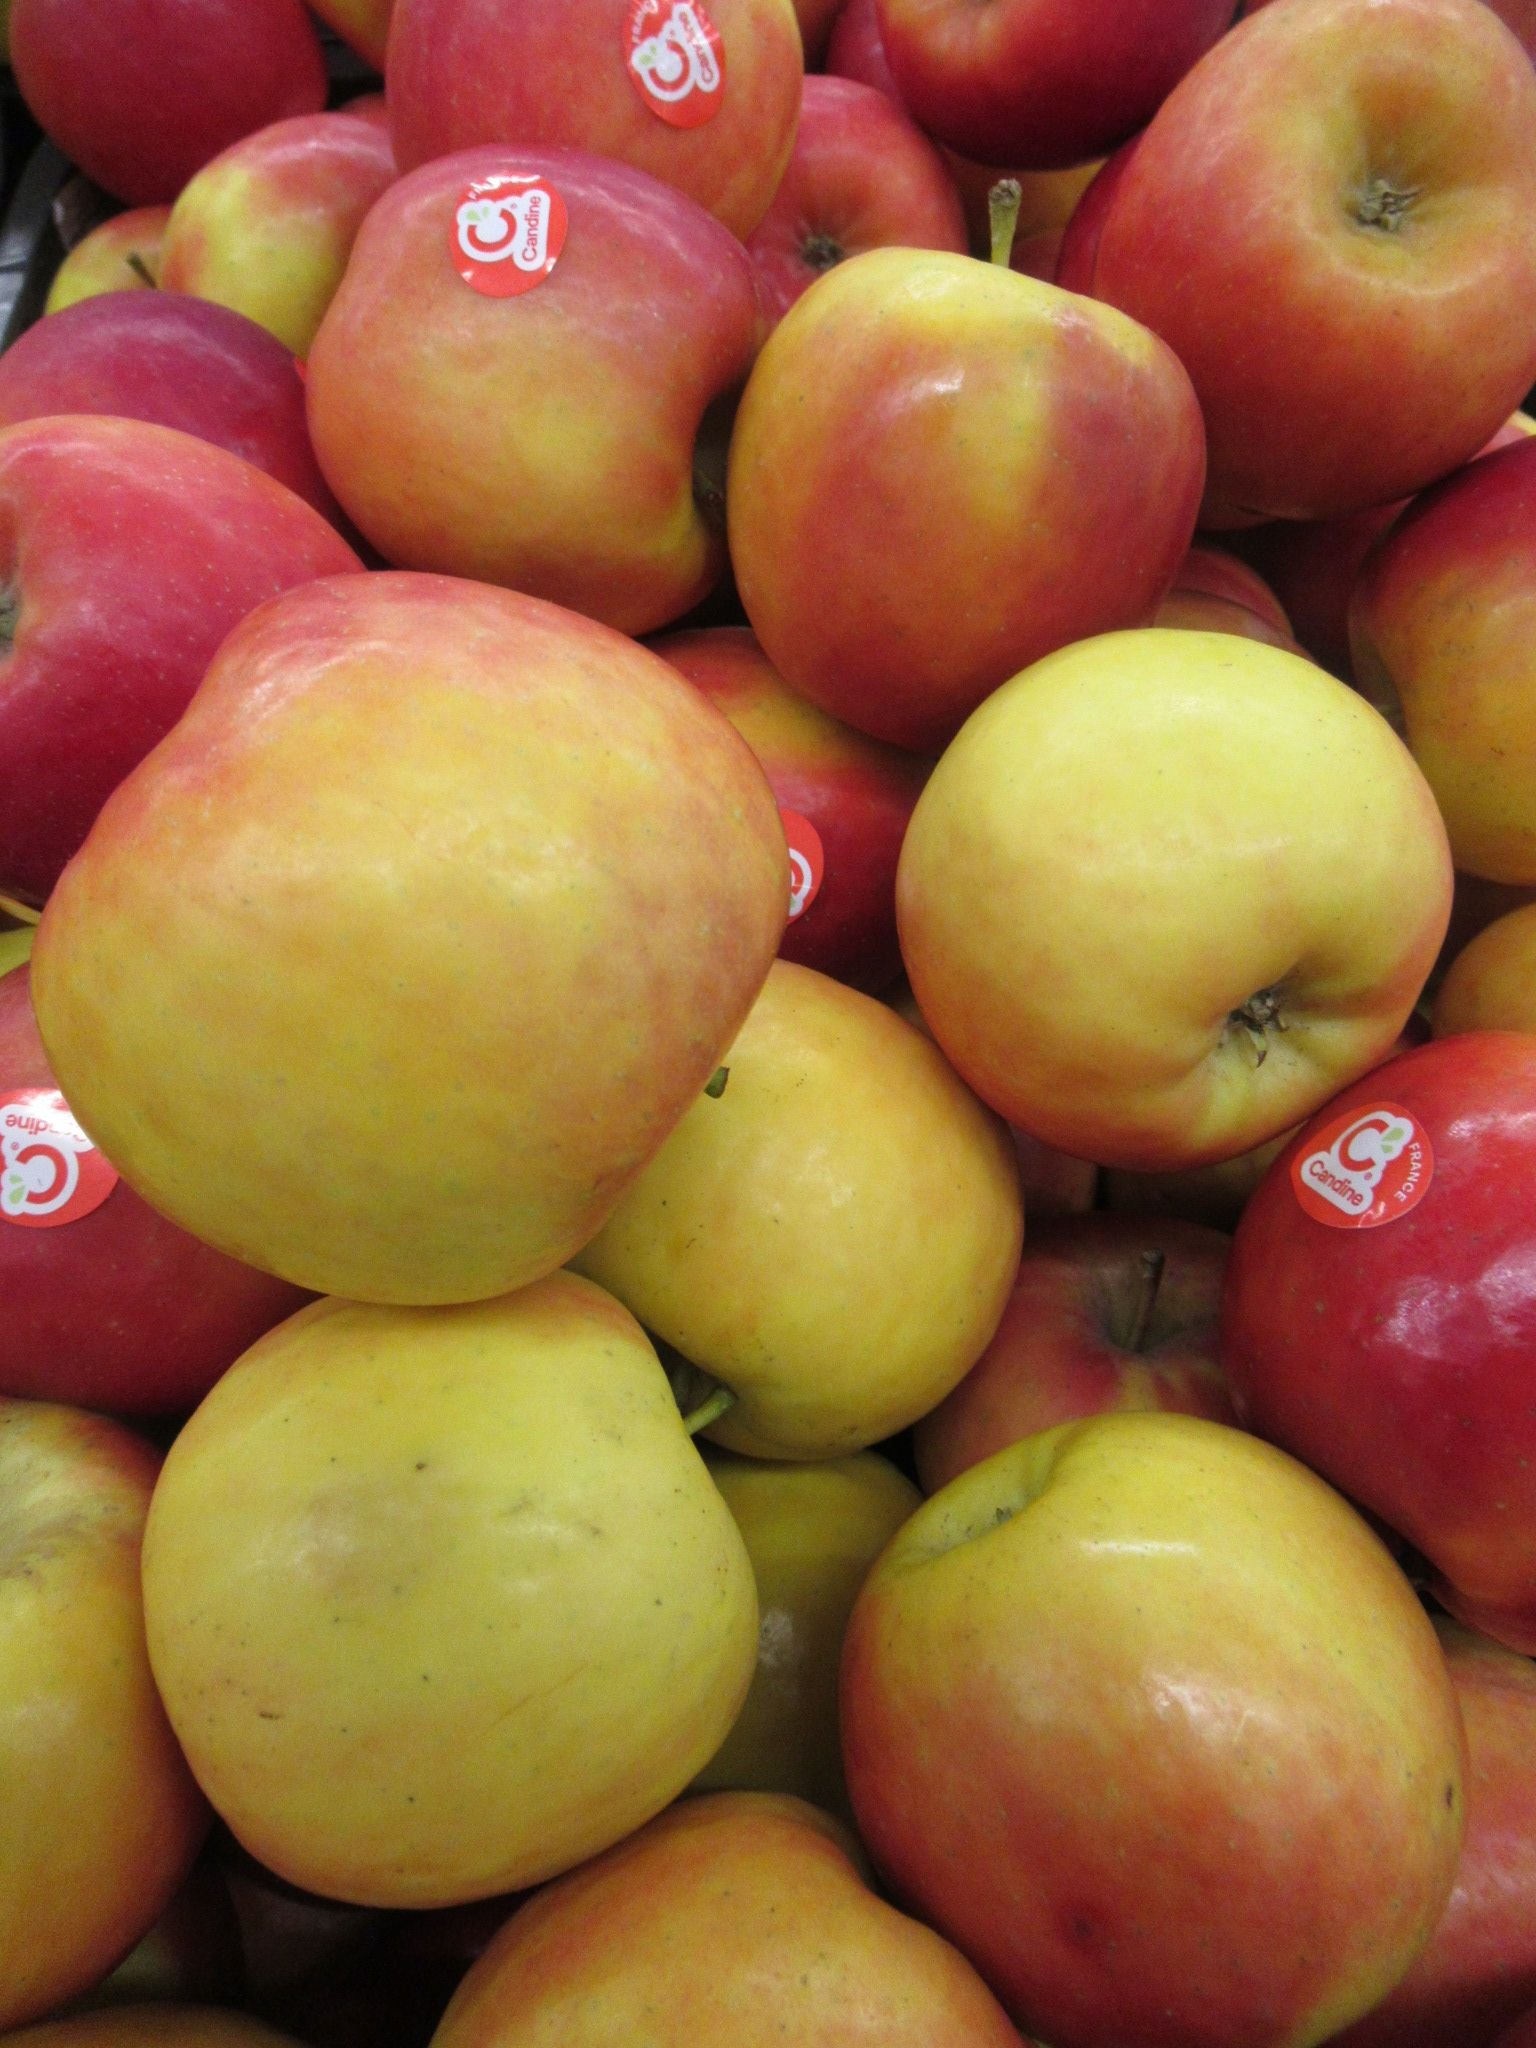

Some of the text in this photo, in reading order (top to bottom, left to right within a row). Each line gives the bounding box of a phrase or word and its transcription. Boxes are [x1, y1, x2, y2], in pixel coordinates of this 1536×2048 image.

[522, 196, 541, 262] Candine
[4, 1114, 87, 1142] dine
[1309, 1160, 1364, 1206] Candine
[1393, 1142, 1422, 1202] FRANCE
